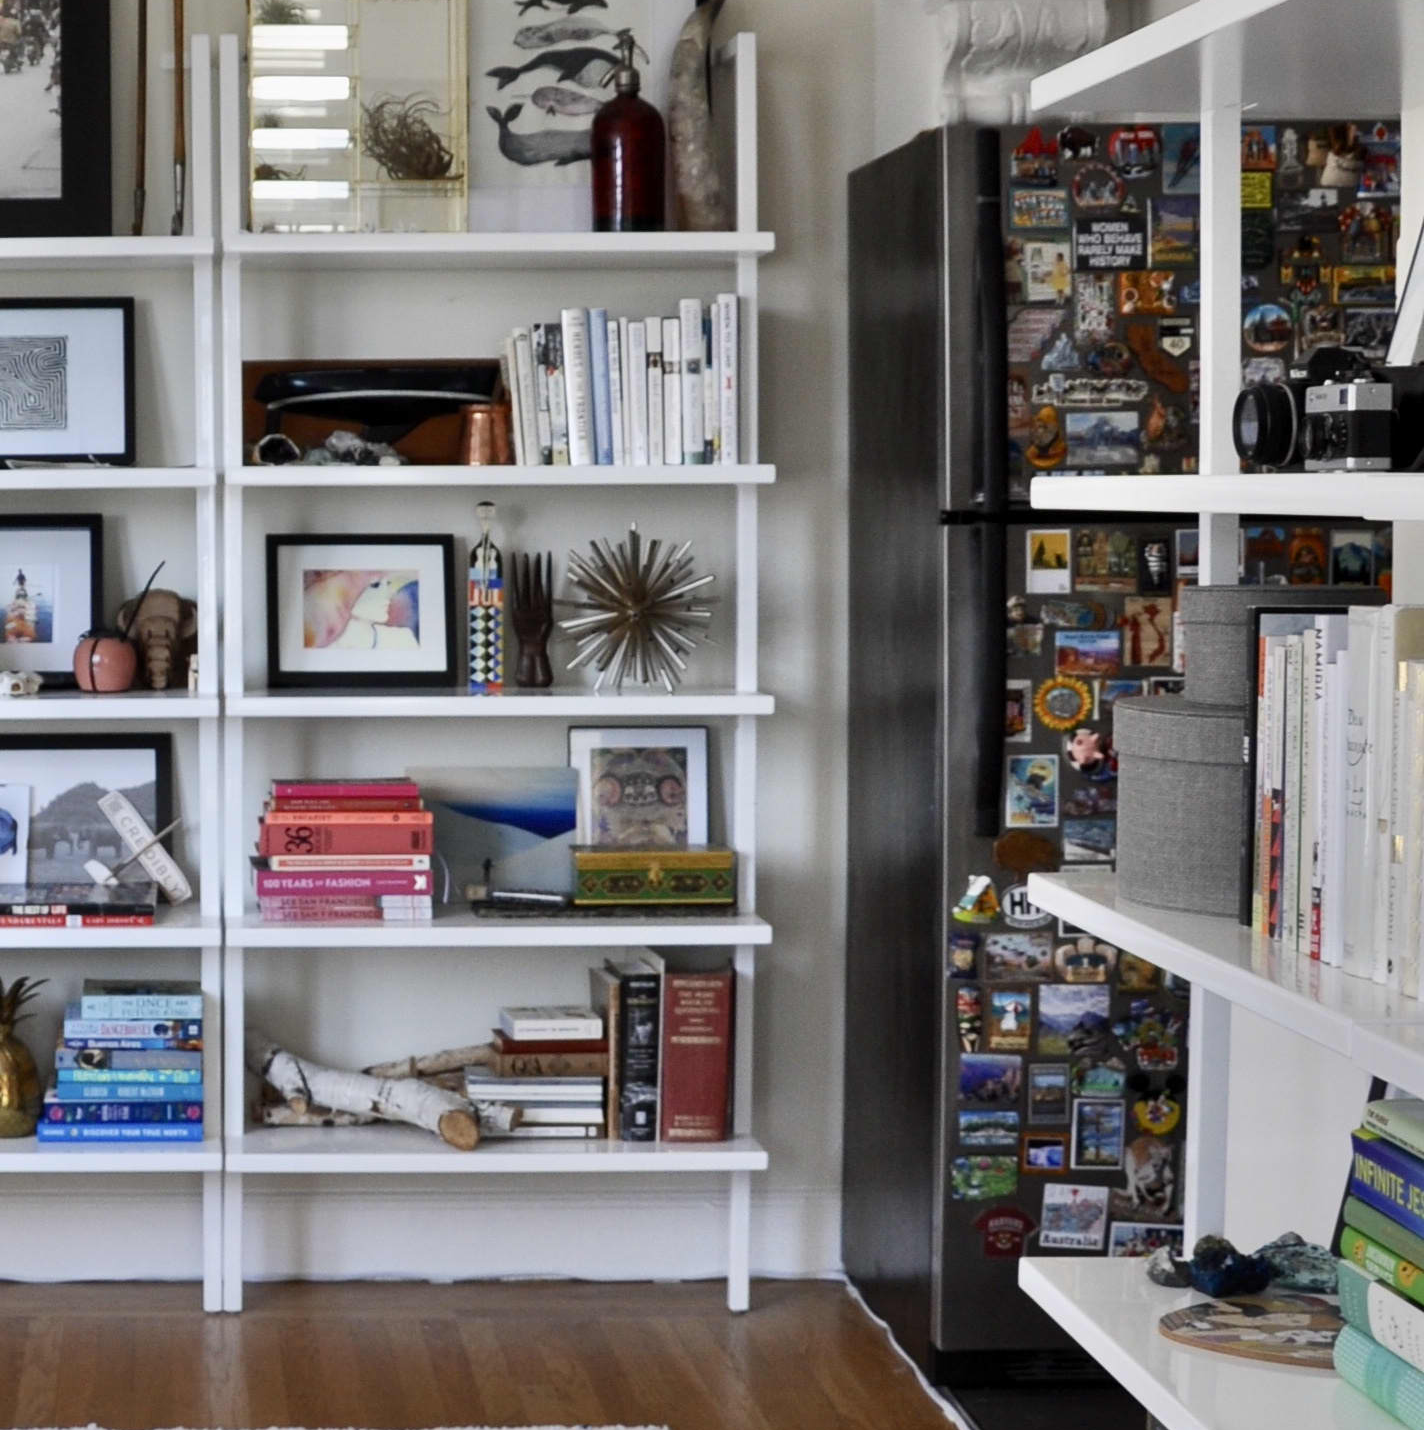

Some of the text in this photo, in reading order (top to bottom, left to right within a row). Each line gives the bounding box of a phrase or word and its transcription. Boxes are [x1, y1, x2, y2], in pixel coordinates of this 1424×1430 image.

[1091, 222, 1129, 233] WOMEN
[1078, 233, 1143, 244] WHO BEHAVE
[1078, 245, 1143, 256] RARELY MAKE
[1089, 256, 1131, 268] HISTORY
[284, 826, 314, 854] 36
[282, 878, 314, 889] YEARS
[326, 877, 371, 888] FASHION
[50, 905, 67, 914] LIFE
[87, 1040, 119, 1048] Buenos
[83, 1128, 120, 1137] DISCOVER
[1354, 1152, 1405, 1205] INFINITE
[1042, 1234, 1099, 1248] Australia
